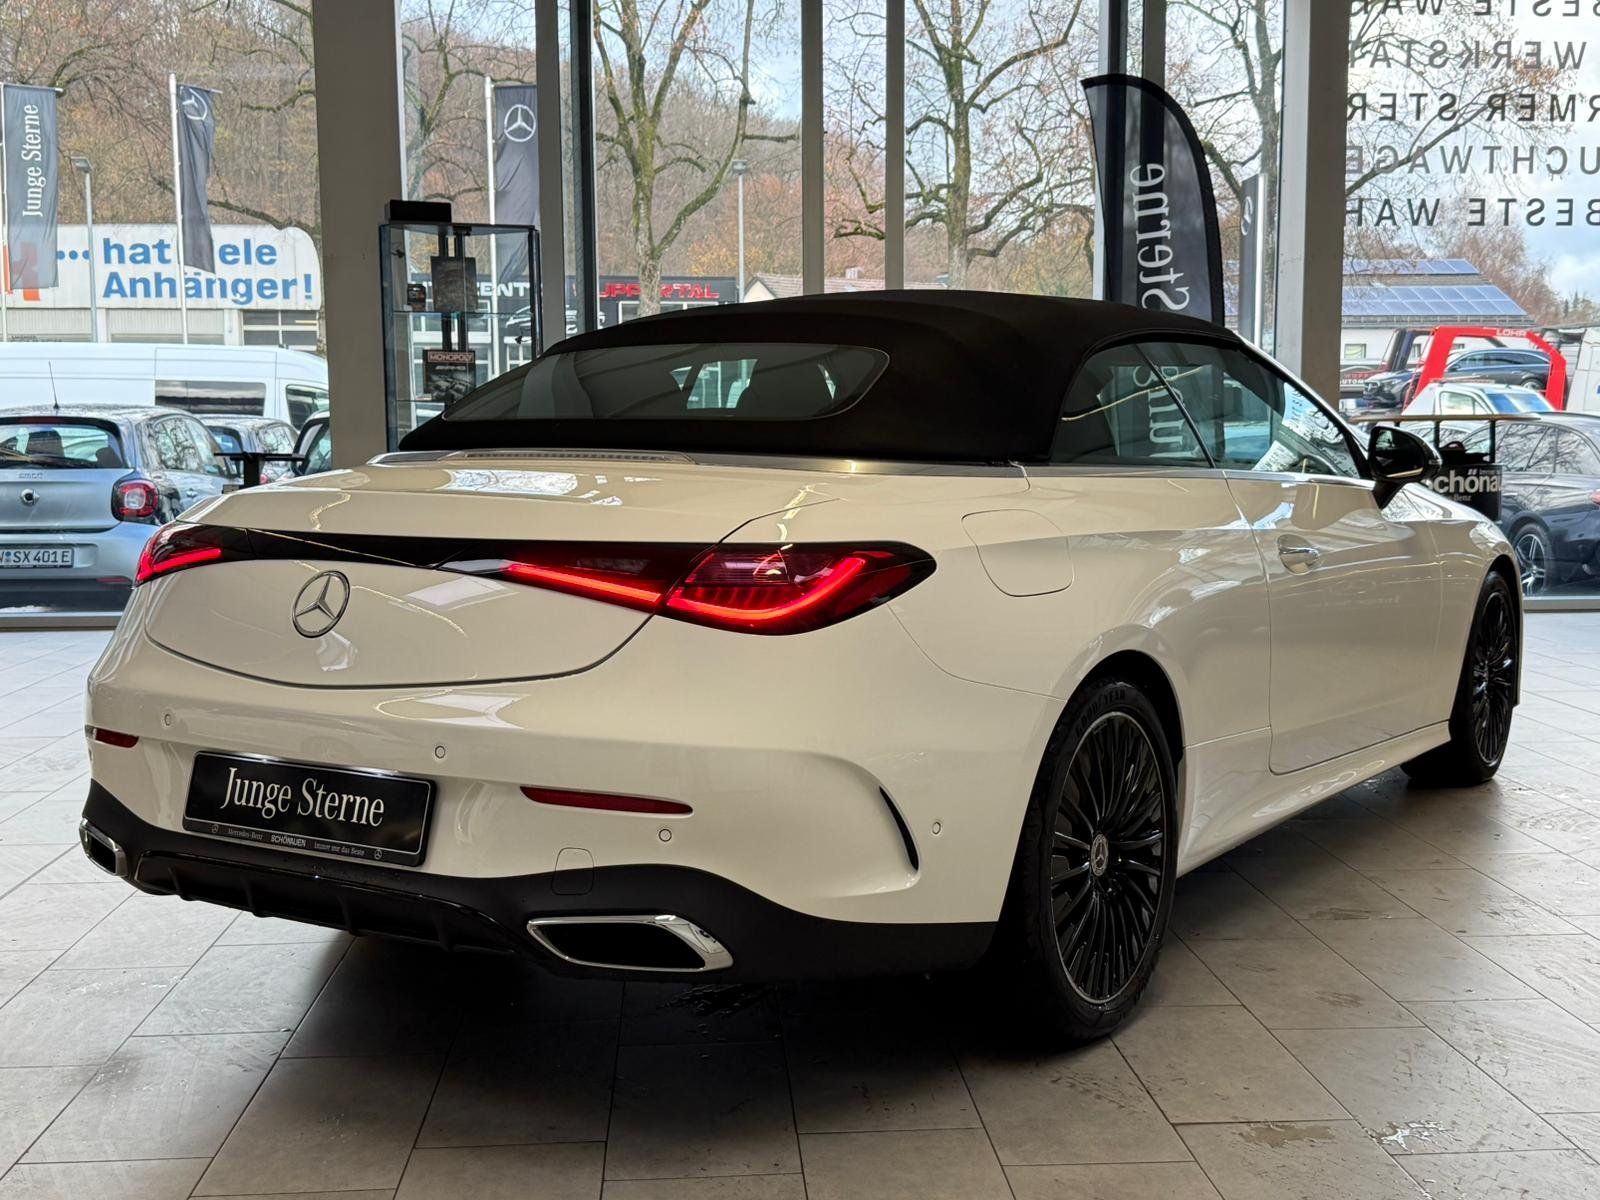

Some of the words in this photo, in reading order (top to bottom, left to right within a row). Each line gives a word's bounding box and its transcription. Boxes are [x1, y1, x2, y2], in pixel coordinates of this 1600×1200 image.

[21, 104, 41, 161] Sterne
[22, 166, 47, 217] Junge
[103, 238, 171, 264] hat
[219, 238, 277, 265] ele
[102, 271, 312, 306] Anhänger!
[220, 767, 292, 819] Junge
[297, 778, 385, 827] Sterne
